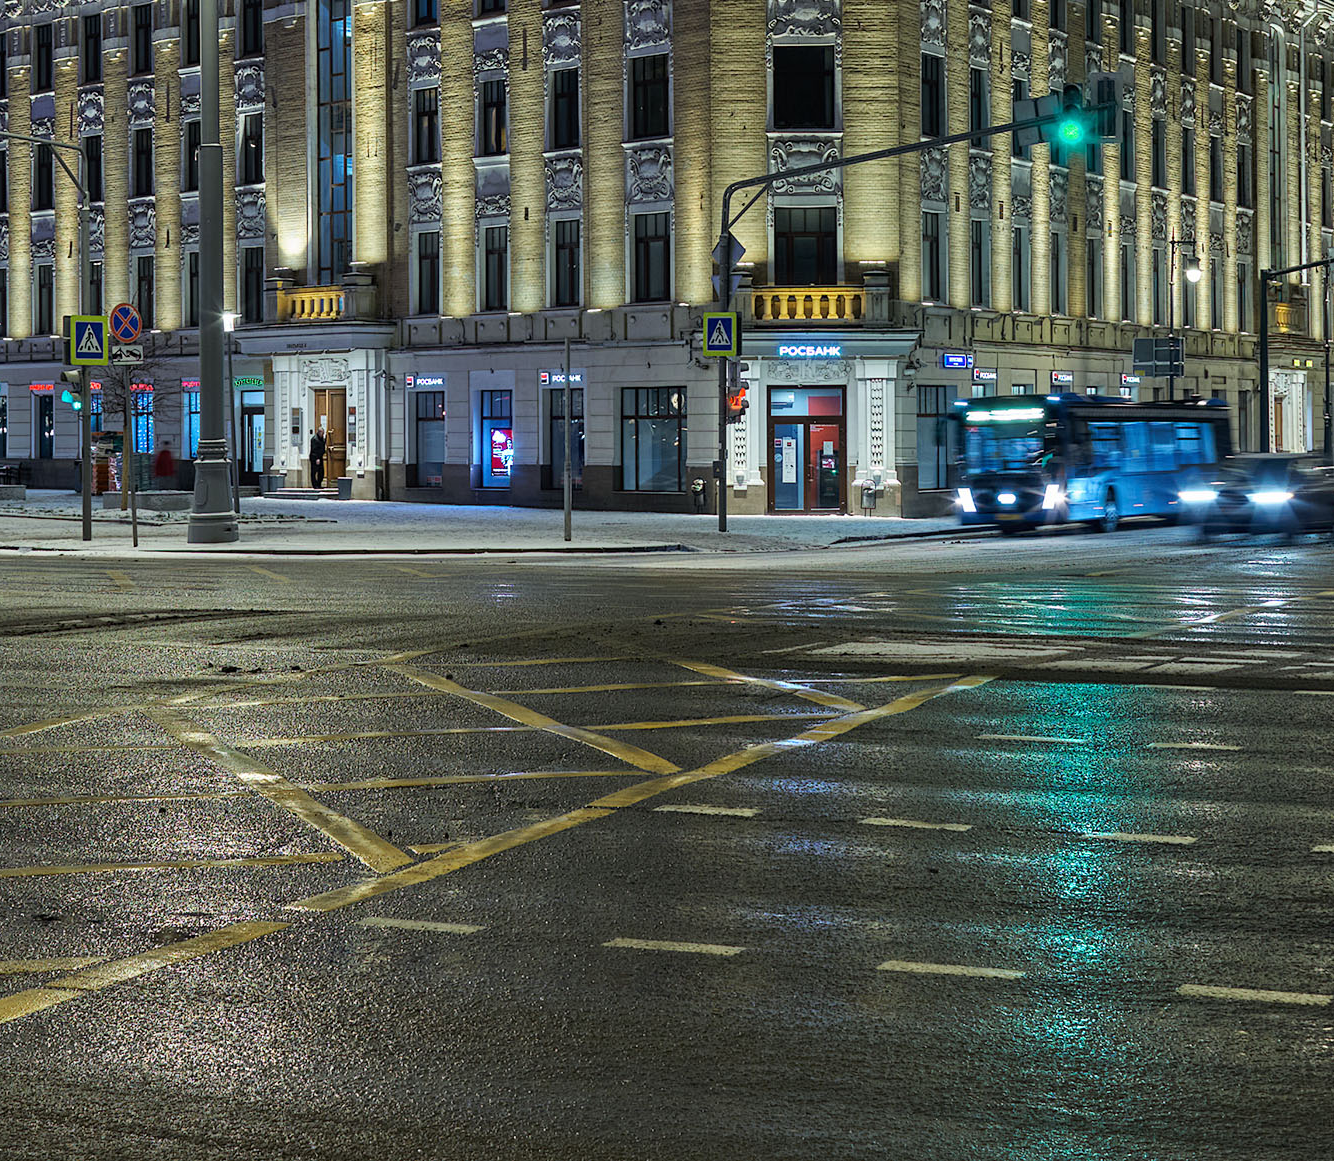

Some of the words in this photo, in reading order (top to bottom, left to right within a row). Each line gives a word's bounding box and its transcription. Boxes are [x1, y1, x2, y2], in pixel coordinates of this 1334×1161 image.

[779, 345, 841, 357] РОСБАНК
[416, 378, 444, 386] РОСБАНК
[552, 374, 582, 383] РОСАНК
